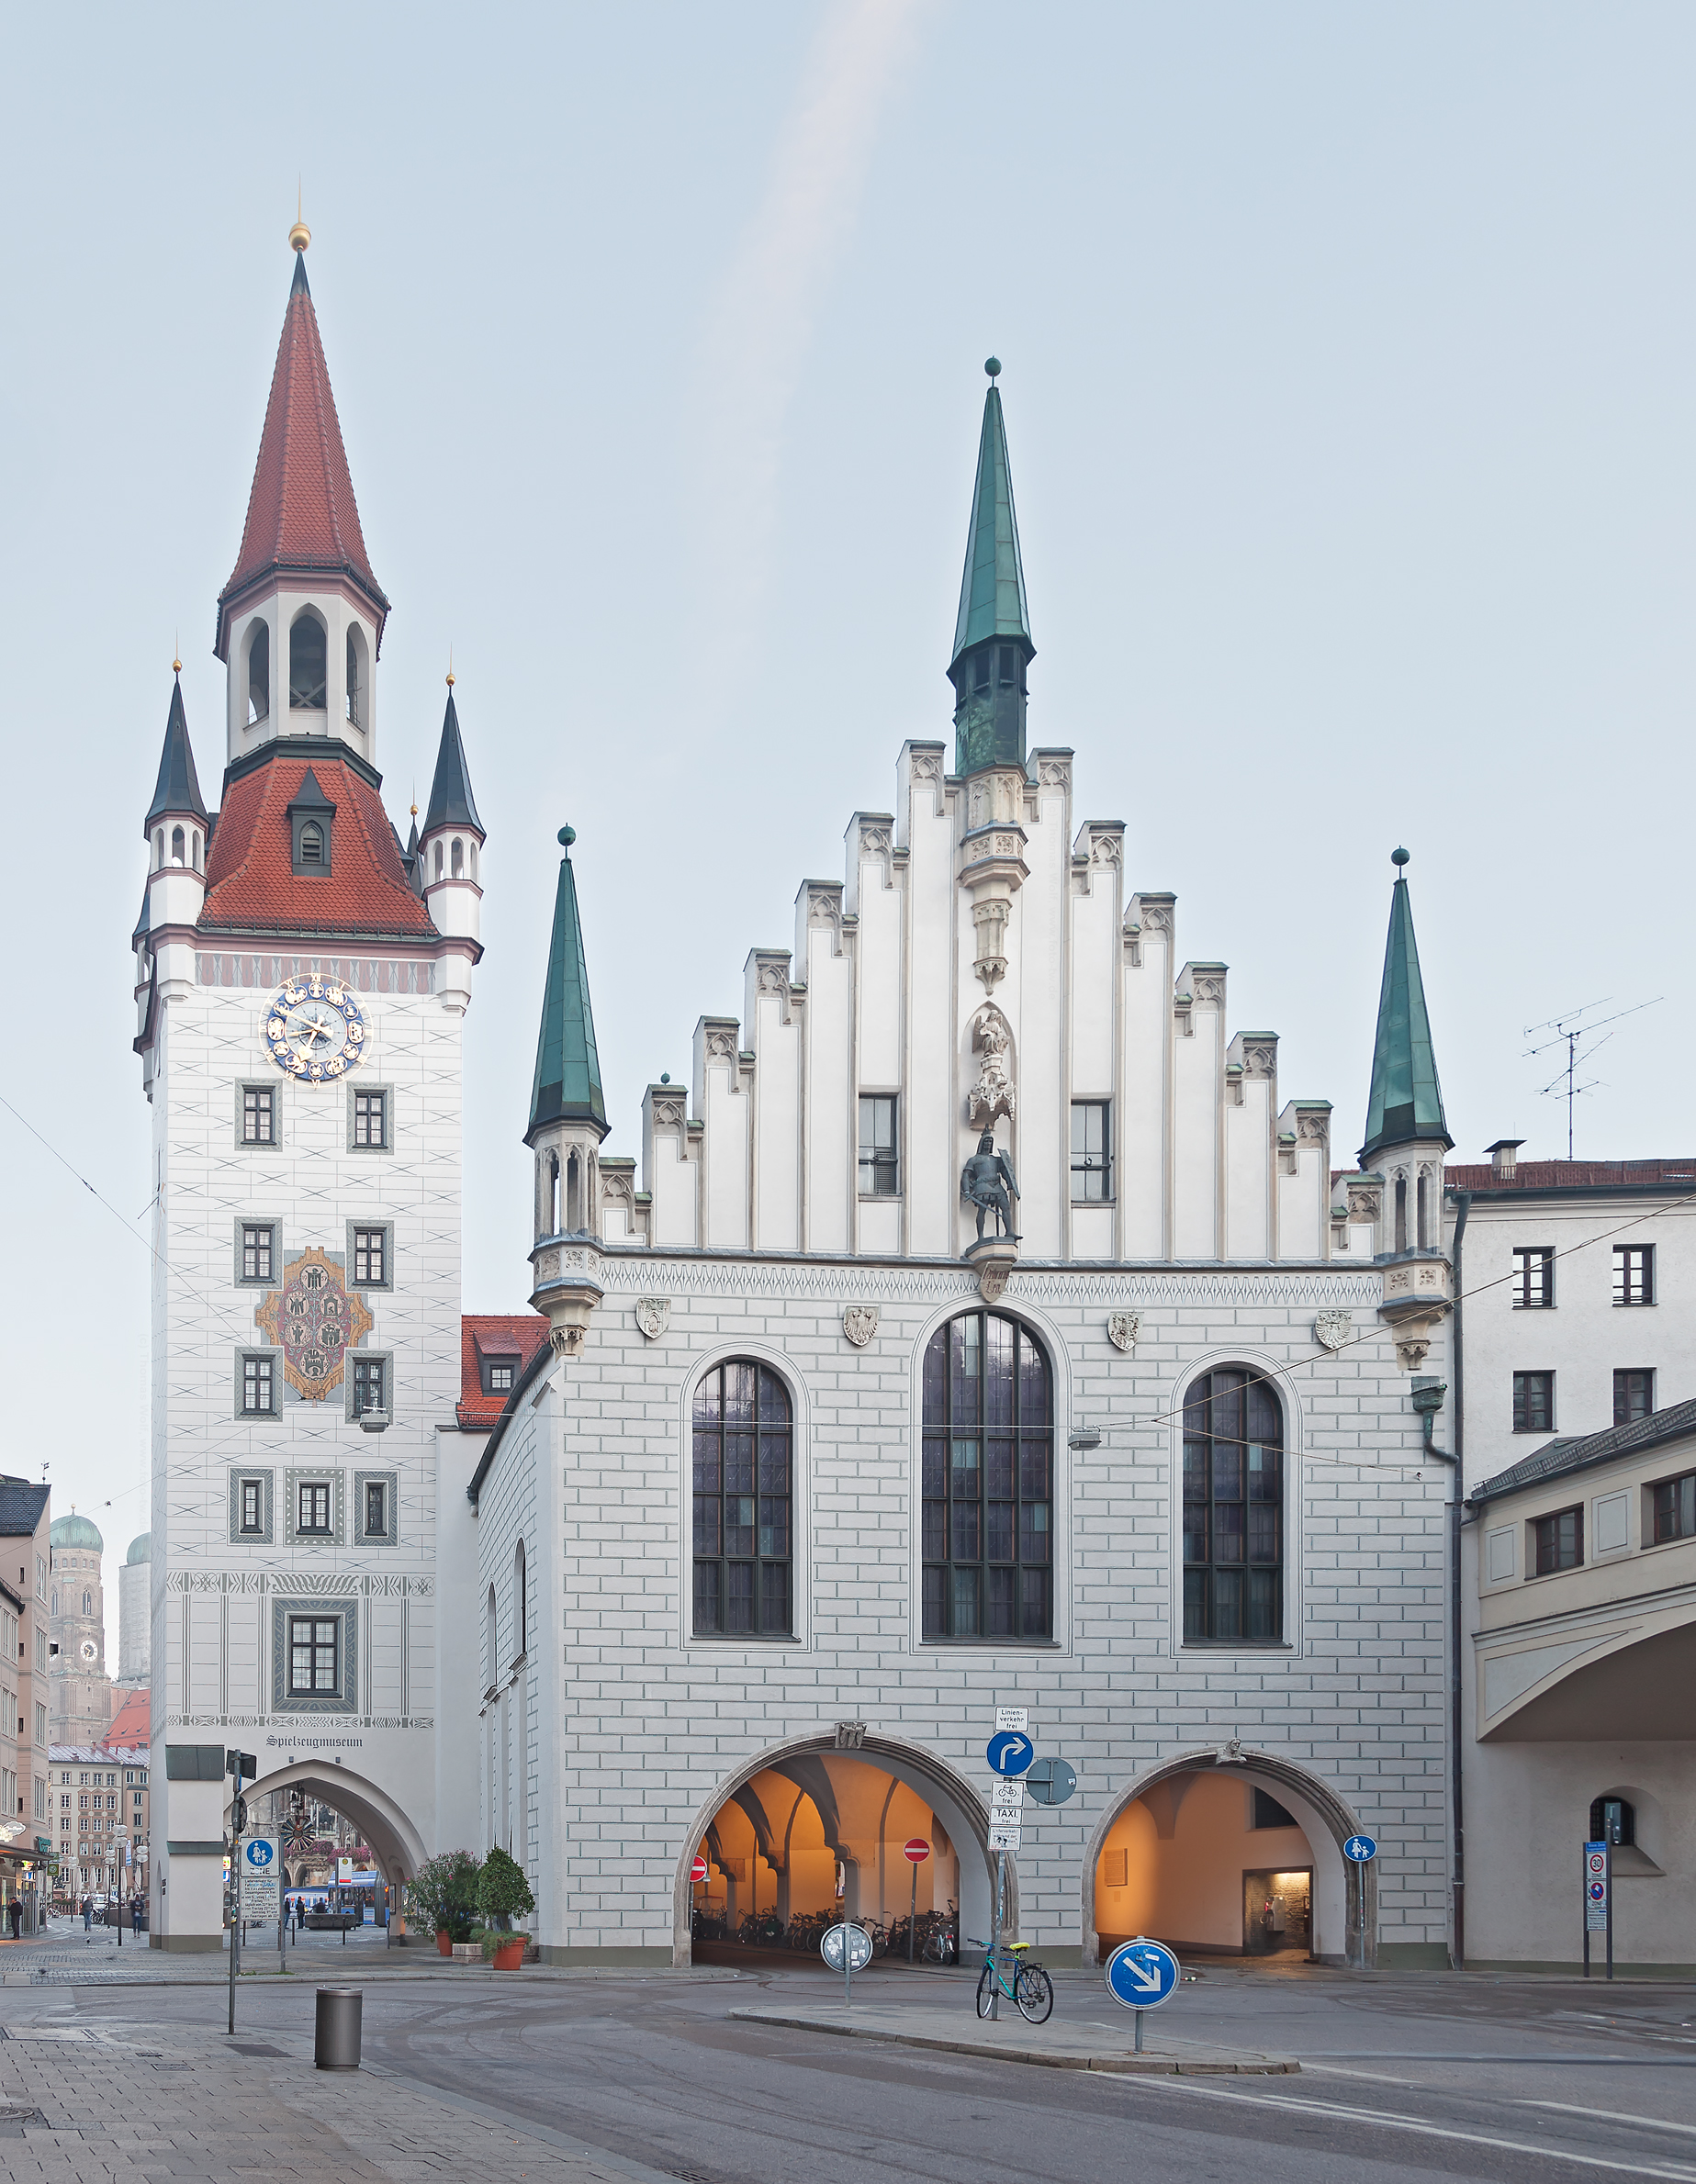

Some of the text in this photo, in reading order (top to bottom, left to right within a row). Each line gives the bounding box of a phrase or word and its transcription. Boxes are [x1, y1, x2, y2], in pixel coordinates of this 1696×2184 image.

[266, 1735, 363, 1749] Spielzeugmuseum
[997, 1809, 1016, 1817] TAXI
[1593, 1859, 1601, 1868] 30
